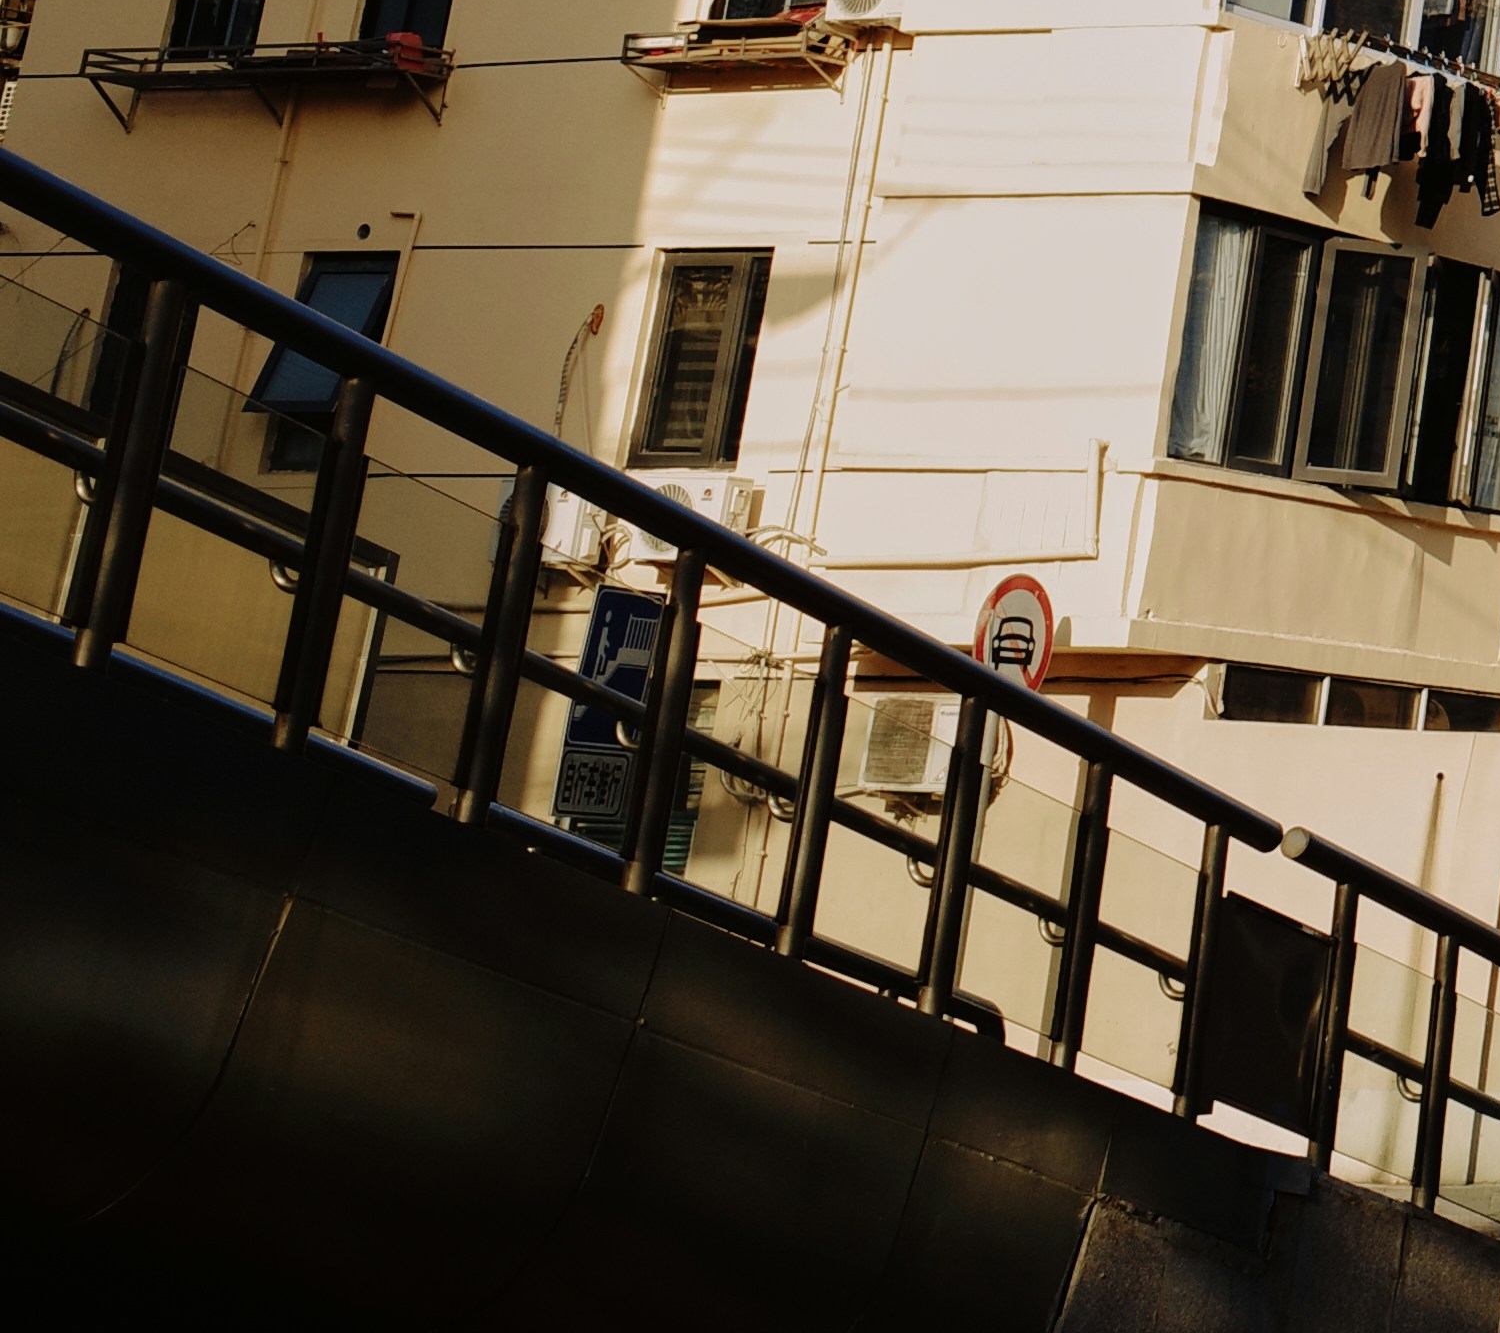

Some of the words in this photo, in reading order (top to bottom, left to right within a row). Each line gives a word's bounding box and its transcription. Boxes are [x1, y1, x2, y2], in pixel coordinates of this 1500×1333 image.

[561, 759, 623, 808] 自行车推行
